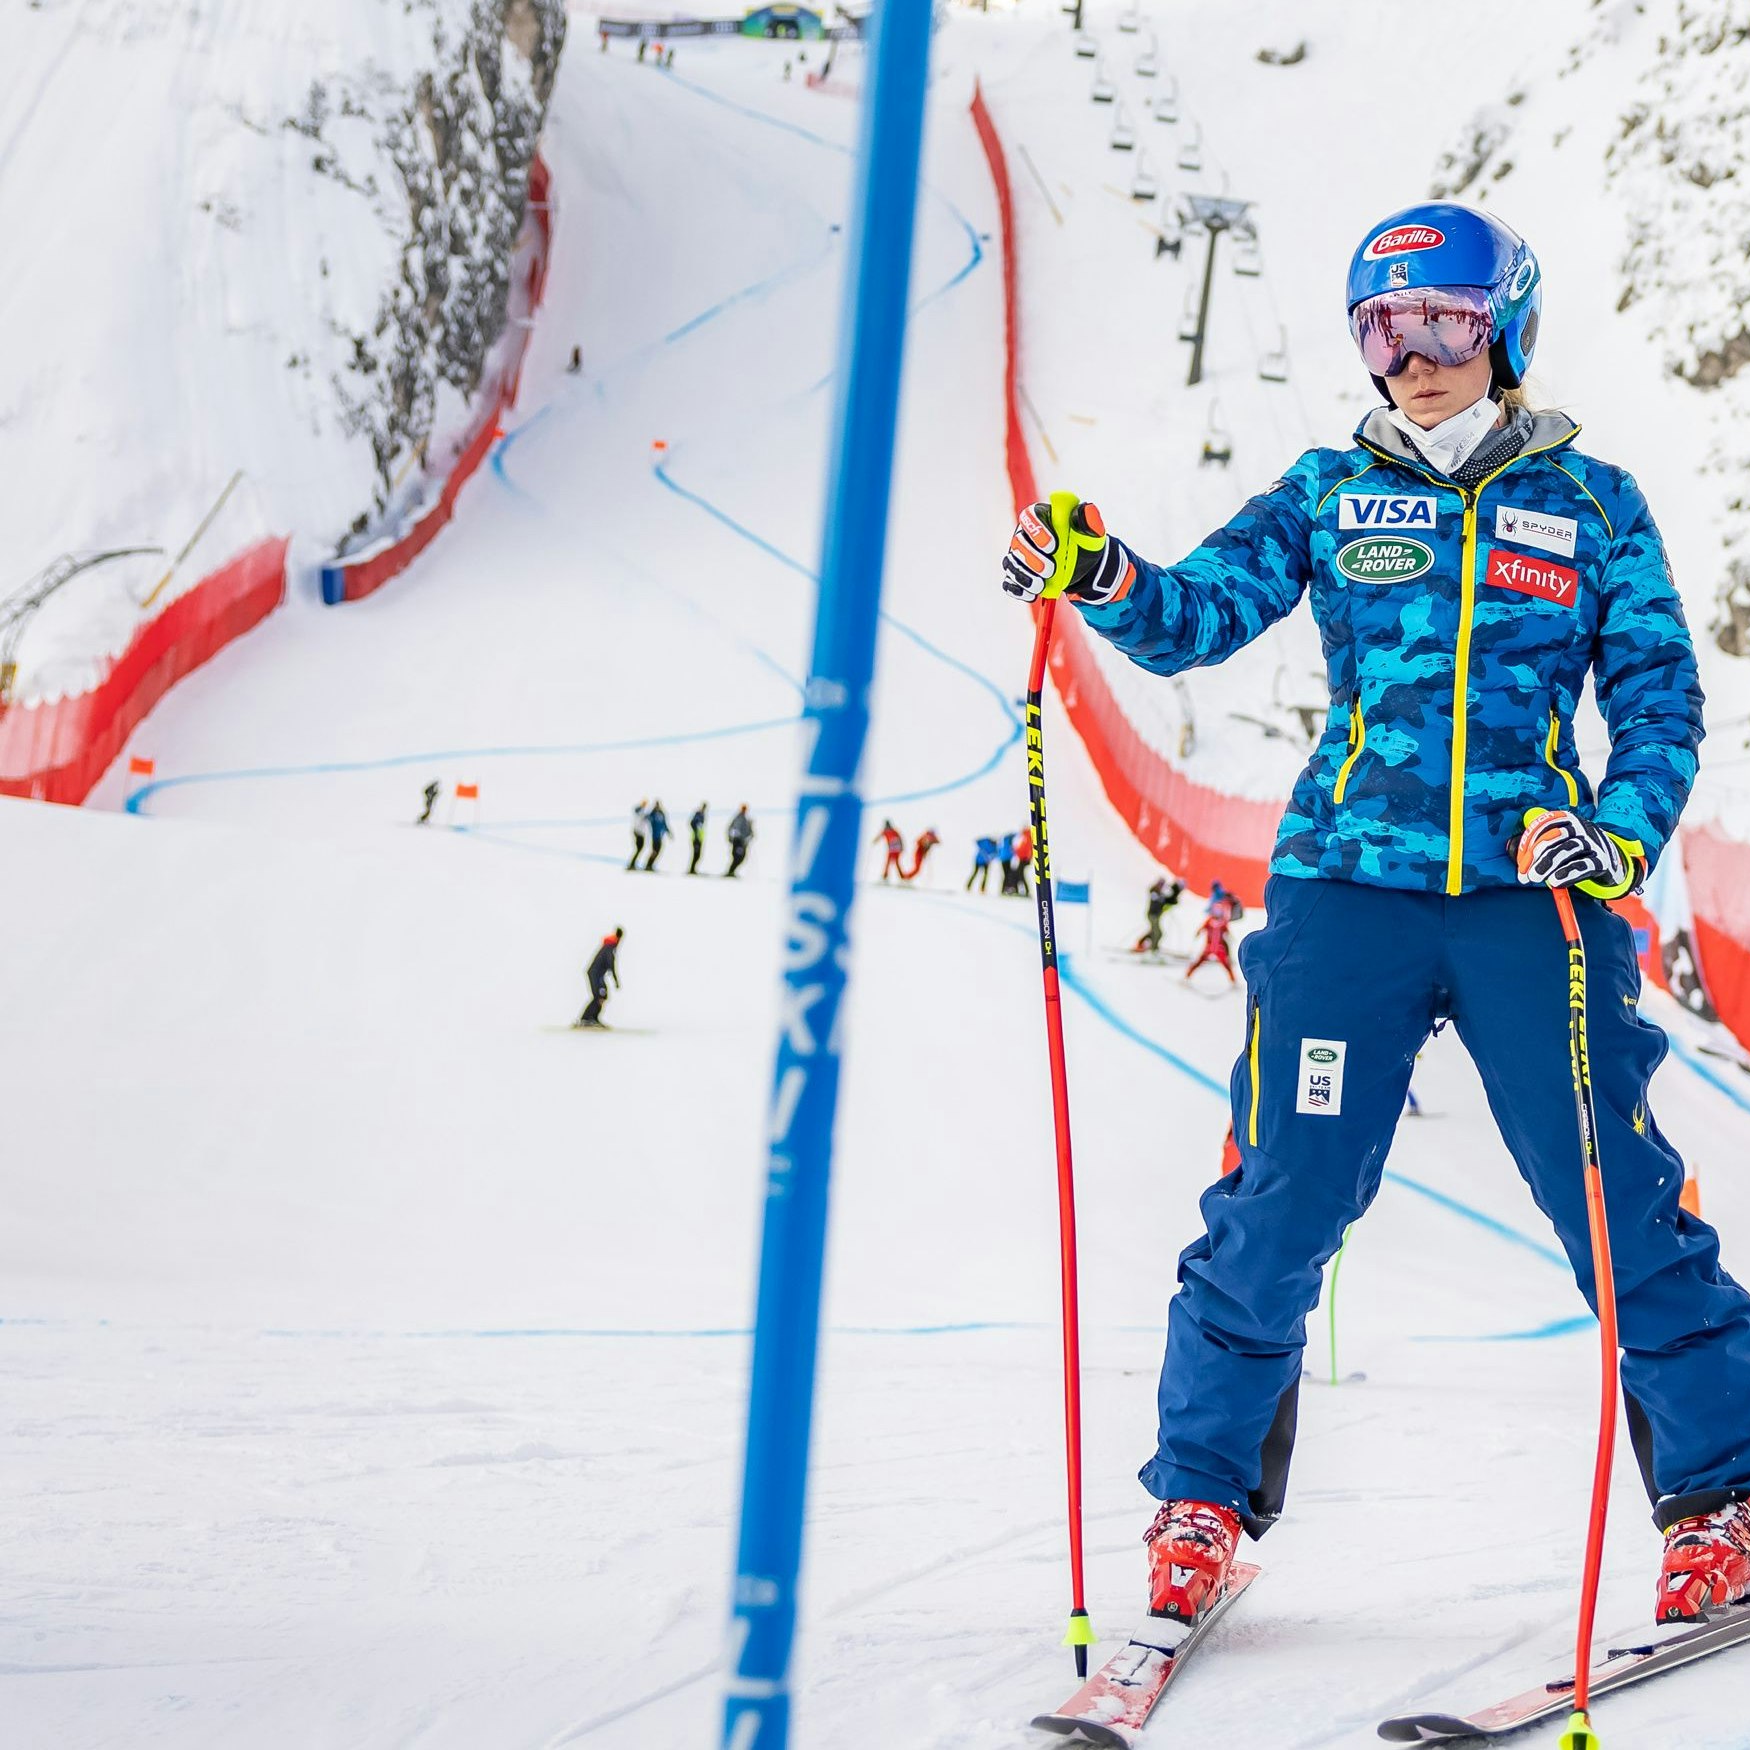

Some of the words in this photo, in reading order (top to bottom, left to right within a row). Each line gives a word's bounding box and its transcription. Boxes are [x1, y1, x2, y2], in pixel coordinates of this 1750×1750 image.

[1377, 229, 1437, 252] Barilla
[1344, 498, 1432, 524] VISA
[1522, 520, 1573, 539] SPYDER
[1357, 545, 1403, 559] LAND
[1360, 558, 1417, 572] ROVER
[1495, 559, 1572, 598] xfinity
[1026, 703, 1044, 787] LEKI
[1041, 901, 1051, 939] CARBON
[1569, 948, 1585, 1010] LEKI
[1309, 1075, 1331, 1086] US
